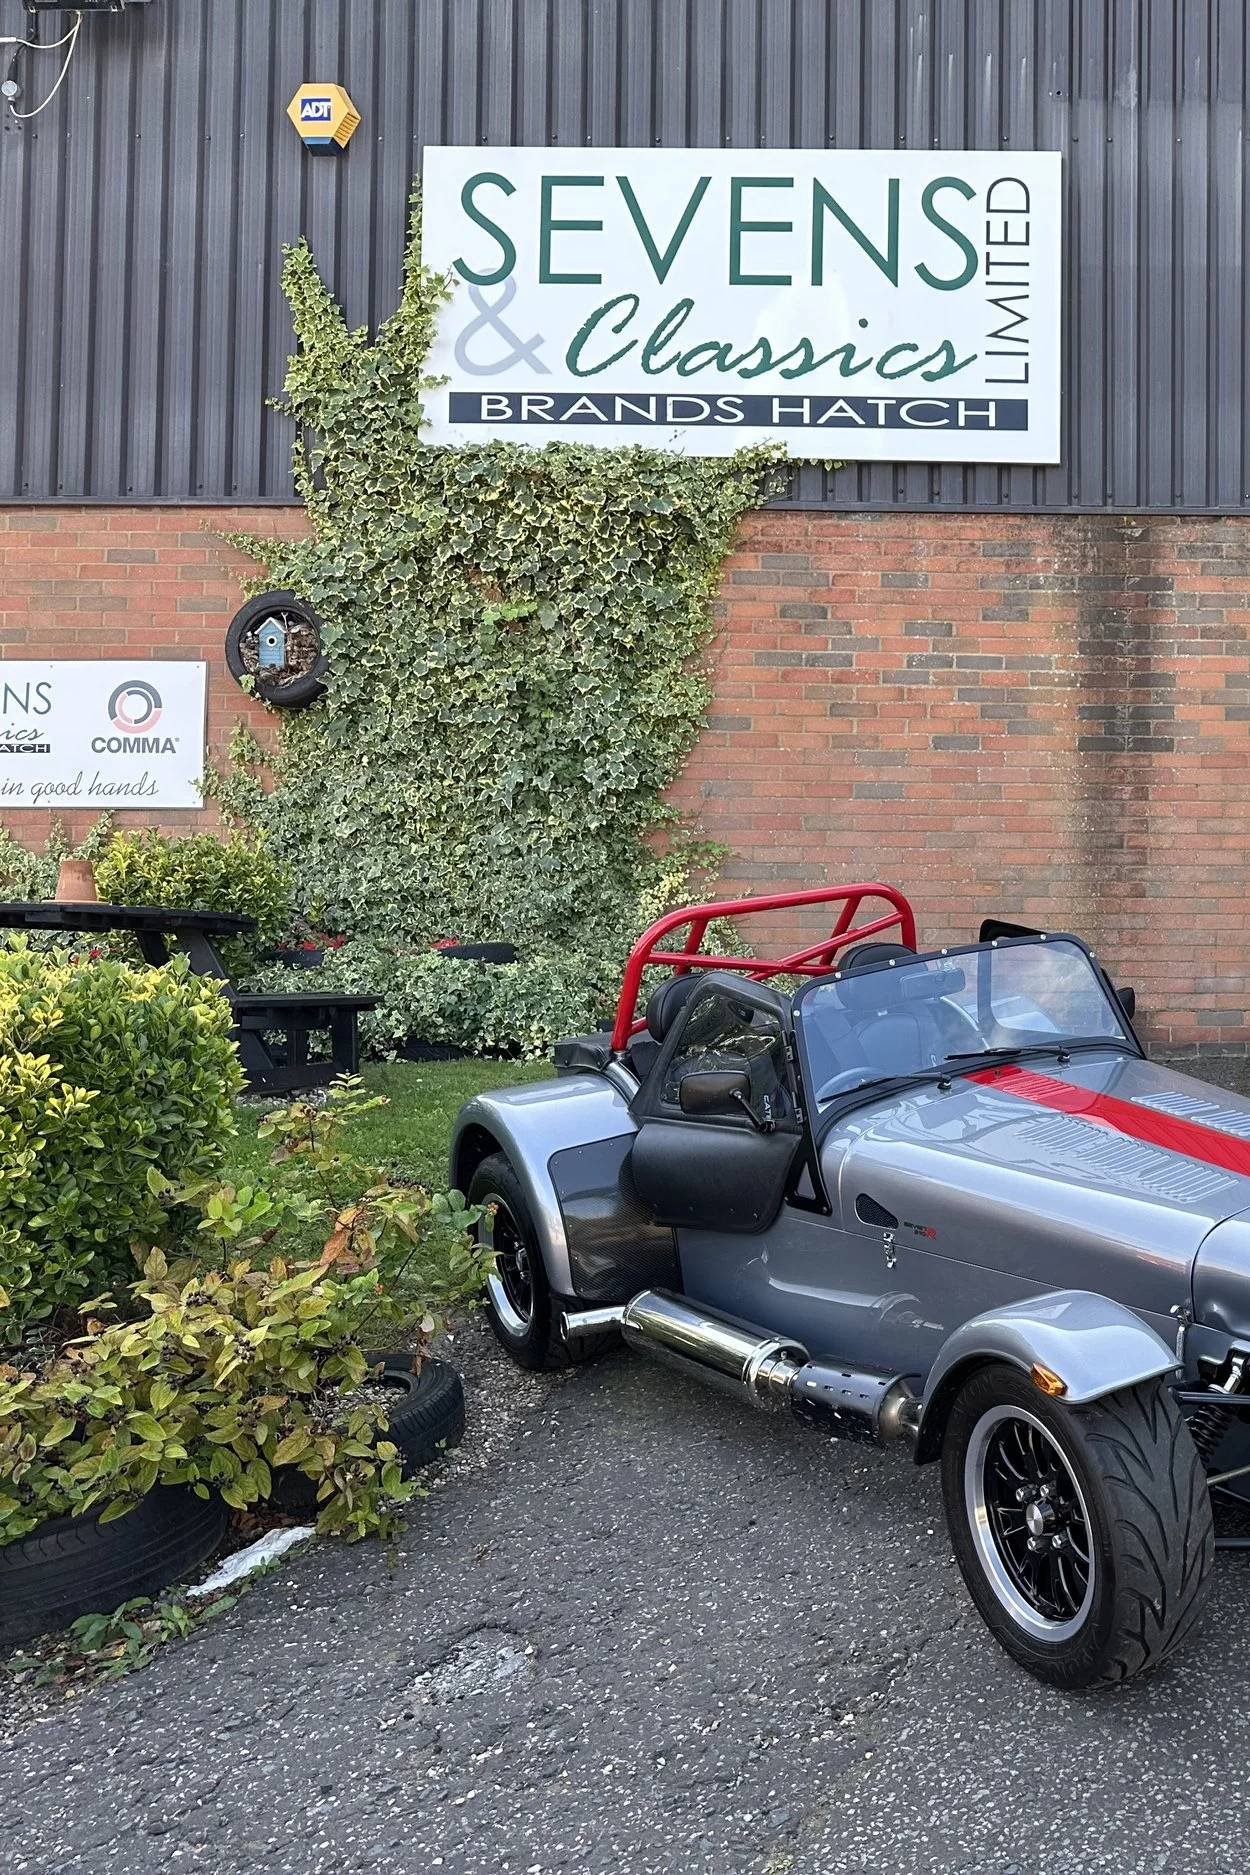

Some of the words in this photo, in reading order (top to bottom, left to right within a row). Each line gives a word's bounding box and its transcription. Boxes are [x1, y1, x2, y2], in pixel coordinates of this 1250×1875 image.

[301, 101, 331, 118] ADT
[452, 171, 979, 291] SEVENS
[985, 177, 1031, 384] LIMITED
[454, 268, 552, 377] &
[565, 293, 978, 382] Classics
[480, 395, 745, 423] BRANDS
[772, 398, 997, 427] HATCH
[91, 736, 176, 754] COMMA
[0, 777, 25, 796] in
[30, 770, 84, 805] good
[88, 770, 160, 796] hands
